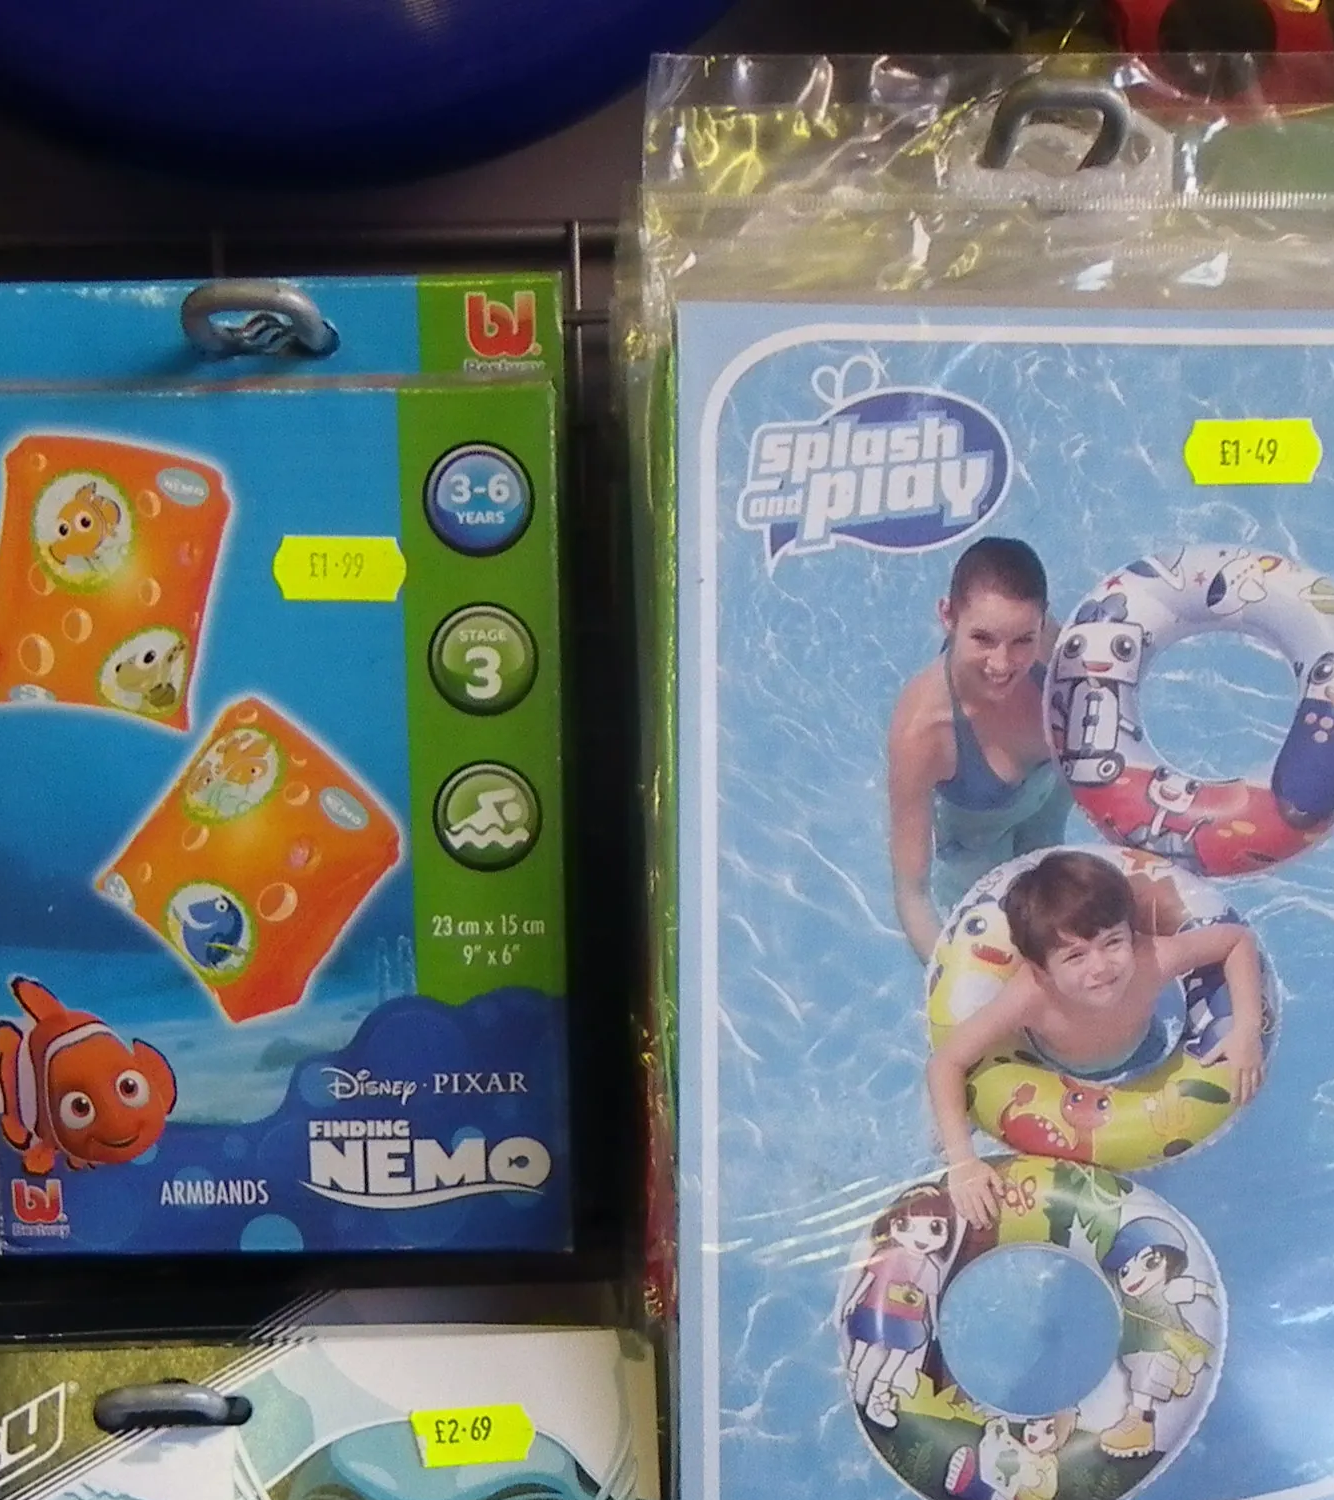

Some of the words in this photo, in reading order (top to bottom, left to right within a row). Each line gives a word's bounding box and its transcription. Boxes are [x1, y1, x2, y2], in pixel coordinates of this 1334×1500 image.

[759, 414, 960, 476] splash
[447, 473, 512, 504] 3-6
[803, 456, 991, 541] play
[748, 487, 802, 519] and
[455, 509, 506, 527] YEARS
[458, 626, 508, 645] STAGE
[464, 646, 503, 701] 3
[432, 916, 454, 937] 23
[457, 919, 481, 936] cm
[484, 921, 496, 936] x
[500, 915, 520, 935] 15
[522, 918, 546, 935] cm
[487, 949, 498, 965] x
[432, 1071, 528, 1096] PIXAR
[308, 1119, 411, 1140] FINDING
[308, 1135, 552, 1195] NEMO
[160, 1179, 269, 1207] ARMBANDS
